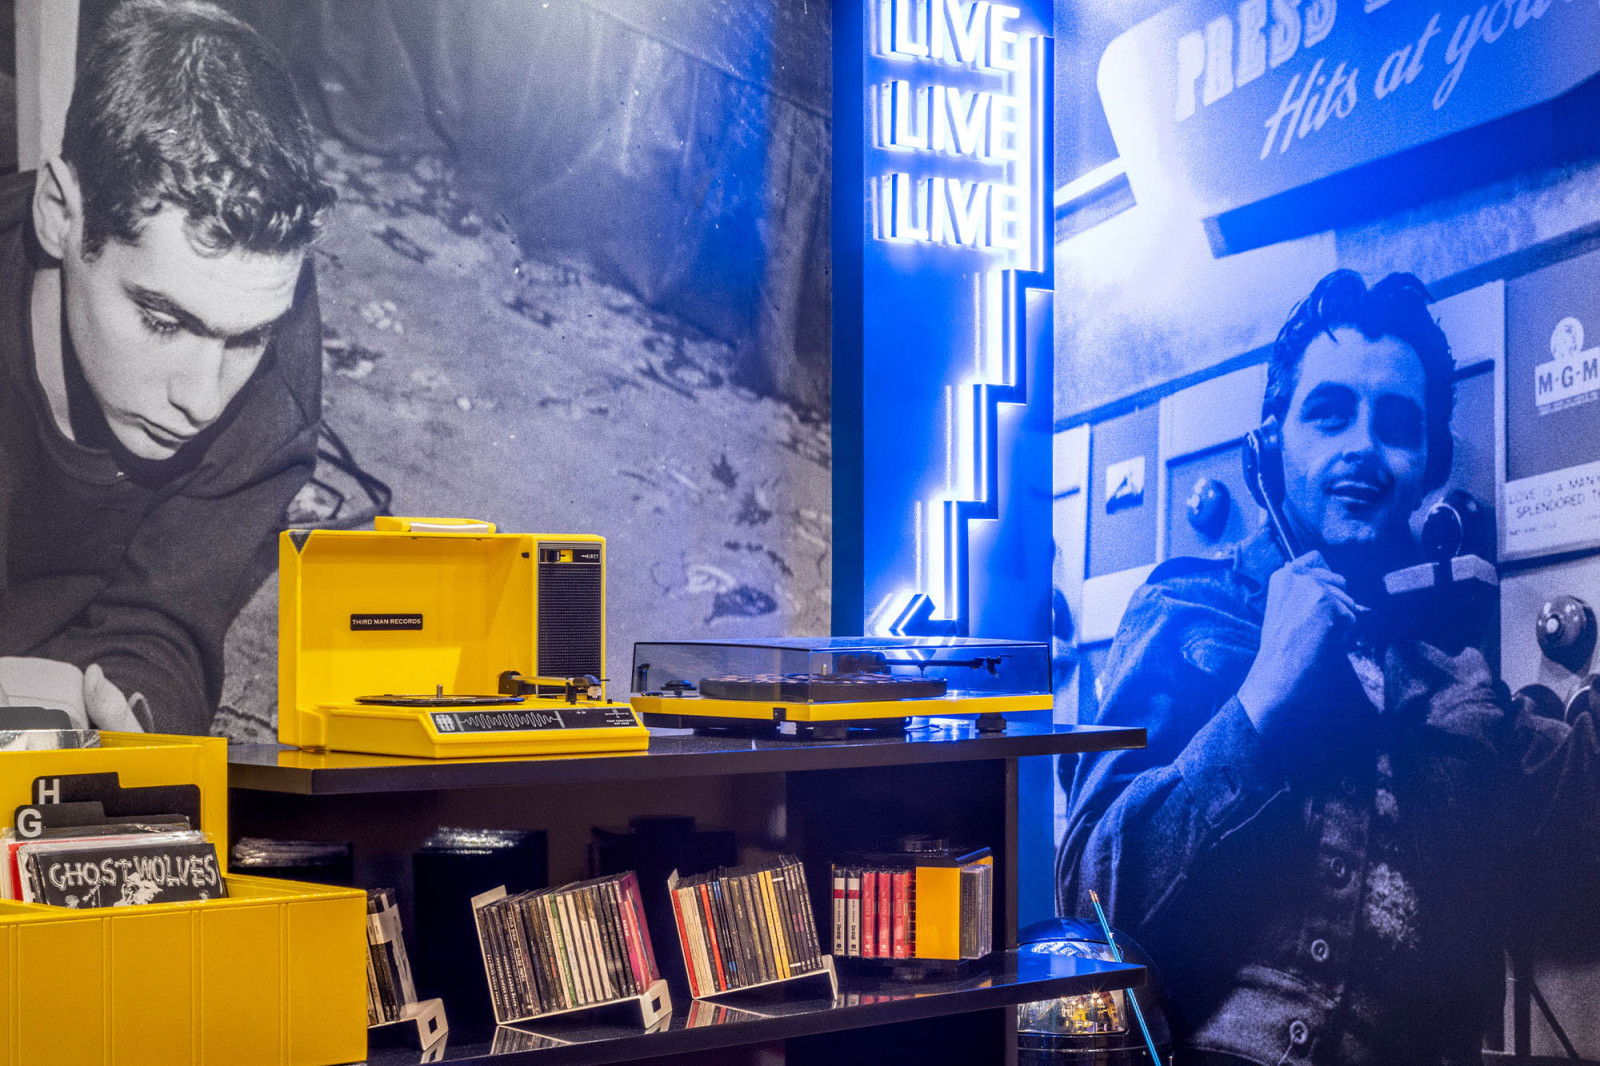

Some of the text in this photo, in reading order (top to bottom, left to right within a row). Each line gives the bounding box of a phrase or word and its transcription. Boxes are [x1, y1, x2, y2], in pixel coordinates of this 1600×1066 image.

[891, 0, 1020, 71] LIVE
[1259, 0, 1571, 161] Hits at you
[891, 80, 1020, 161] LIVE
[891, 172, 1020, 250] LIVE
[17, 808, 42, 838] G
[38, 778, 61, 805] H
[49, 853, 217, 891] GHOST WOLVES
